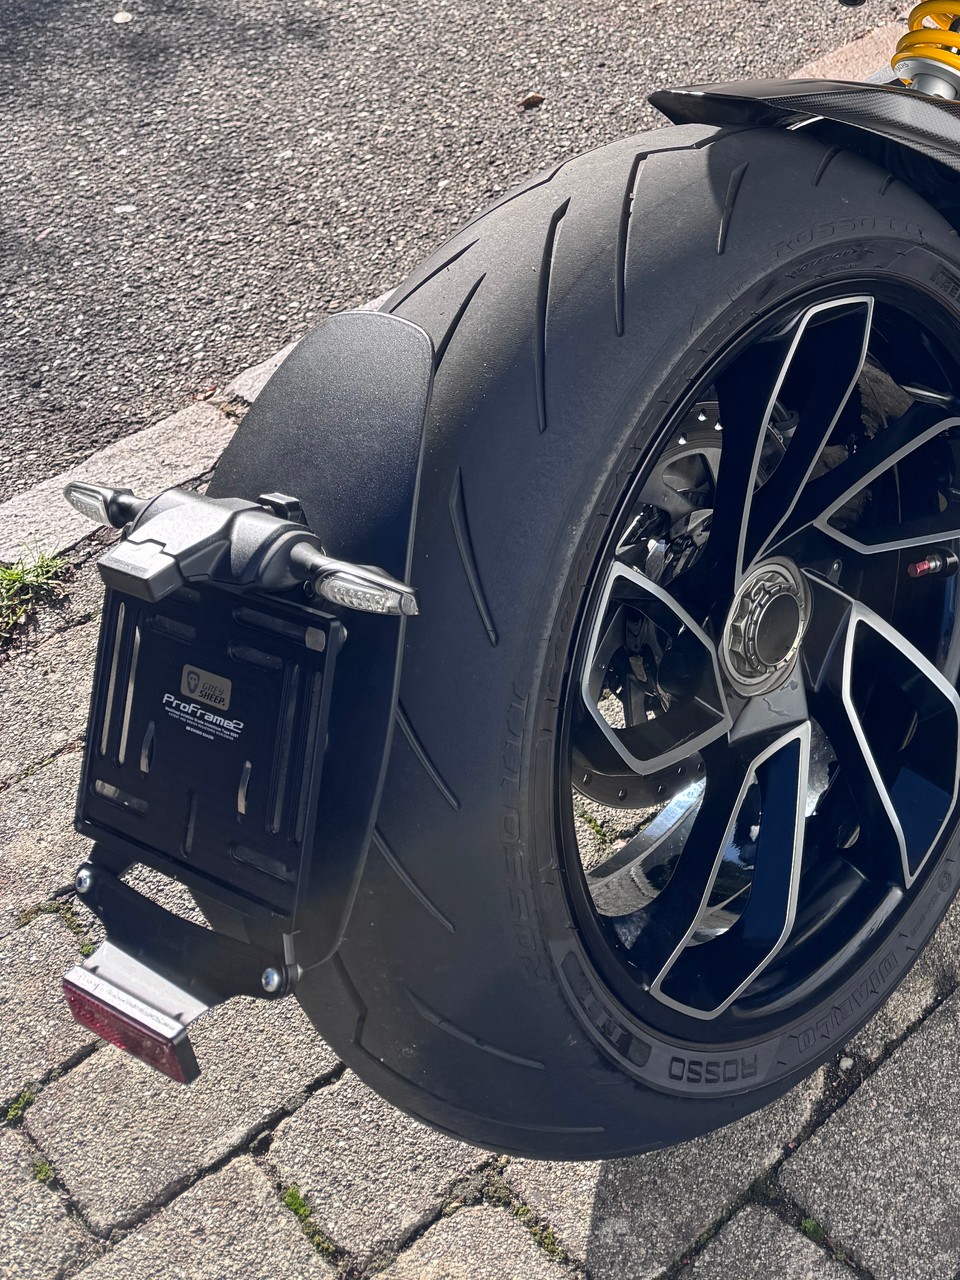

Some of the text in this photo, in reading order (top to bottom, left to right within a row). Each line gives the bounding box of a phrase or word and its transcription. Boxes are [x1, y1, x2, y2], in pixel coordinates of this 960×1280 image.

[202, 682, 225, 697] GREY
[162, 693, 245, 734] ProFrame2
[798, 950, 901, 1055] DIABLO
[668, 1054, 760, 1085] ROSSO
